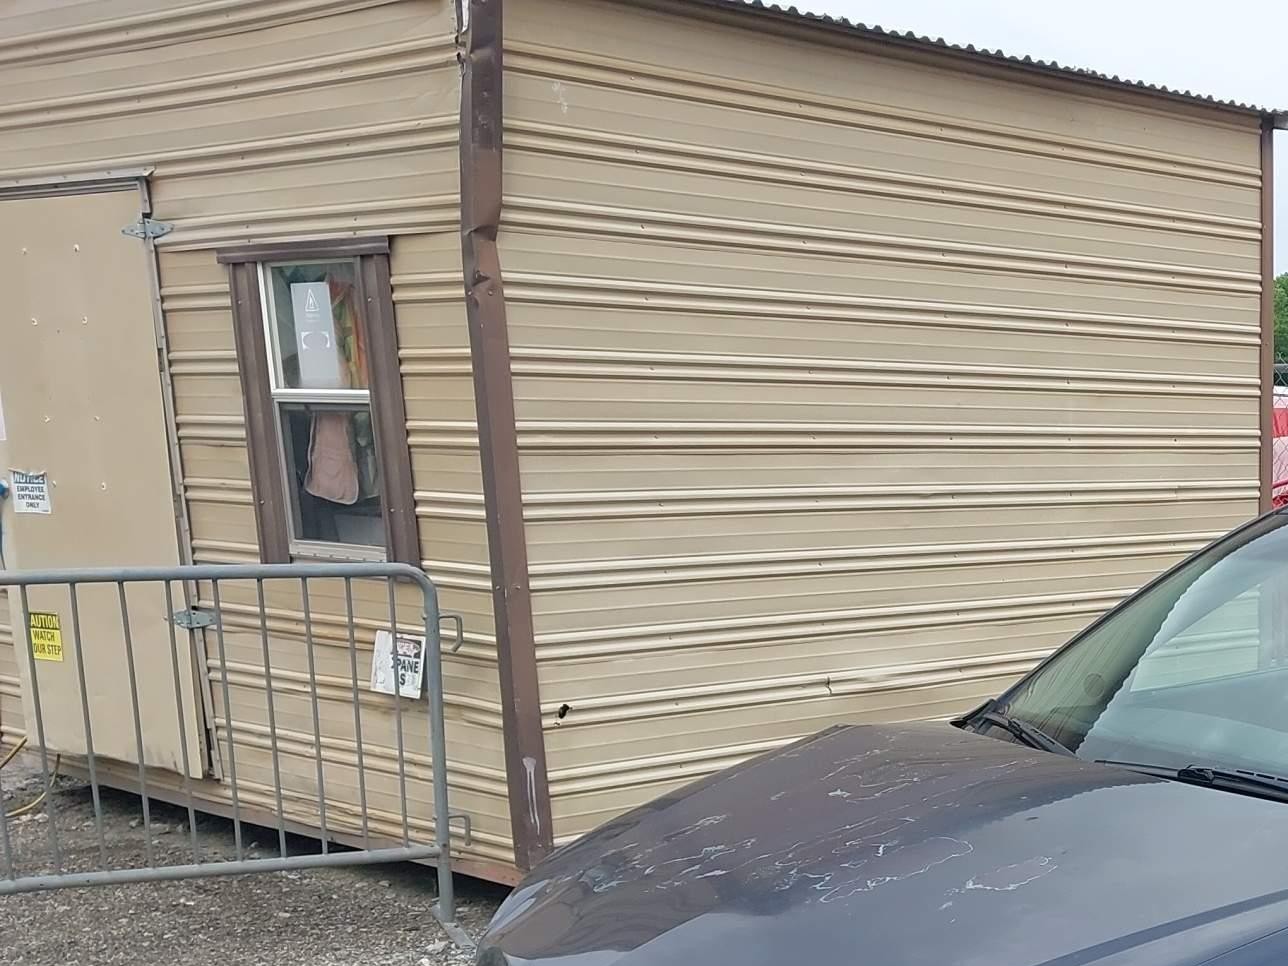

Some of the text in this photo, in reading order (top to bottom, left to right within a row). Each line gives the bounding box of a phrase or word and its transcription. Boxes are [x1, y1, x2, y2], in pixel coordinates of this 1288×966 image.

[18, 493, 46, 501] ENTRANCE
[31, 613, 59, 629] AUTION
[32, 630, 55, 642] WATCH
[33, 642, 61, 656] OUR STEP
